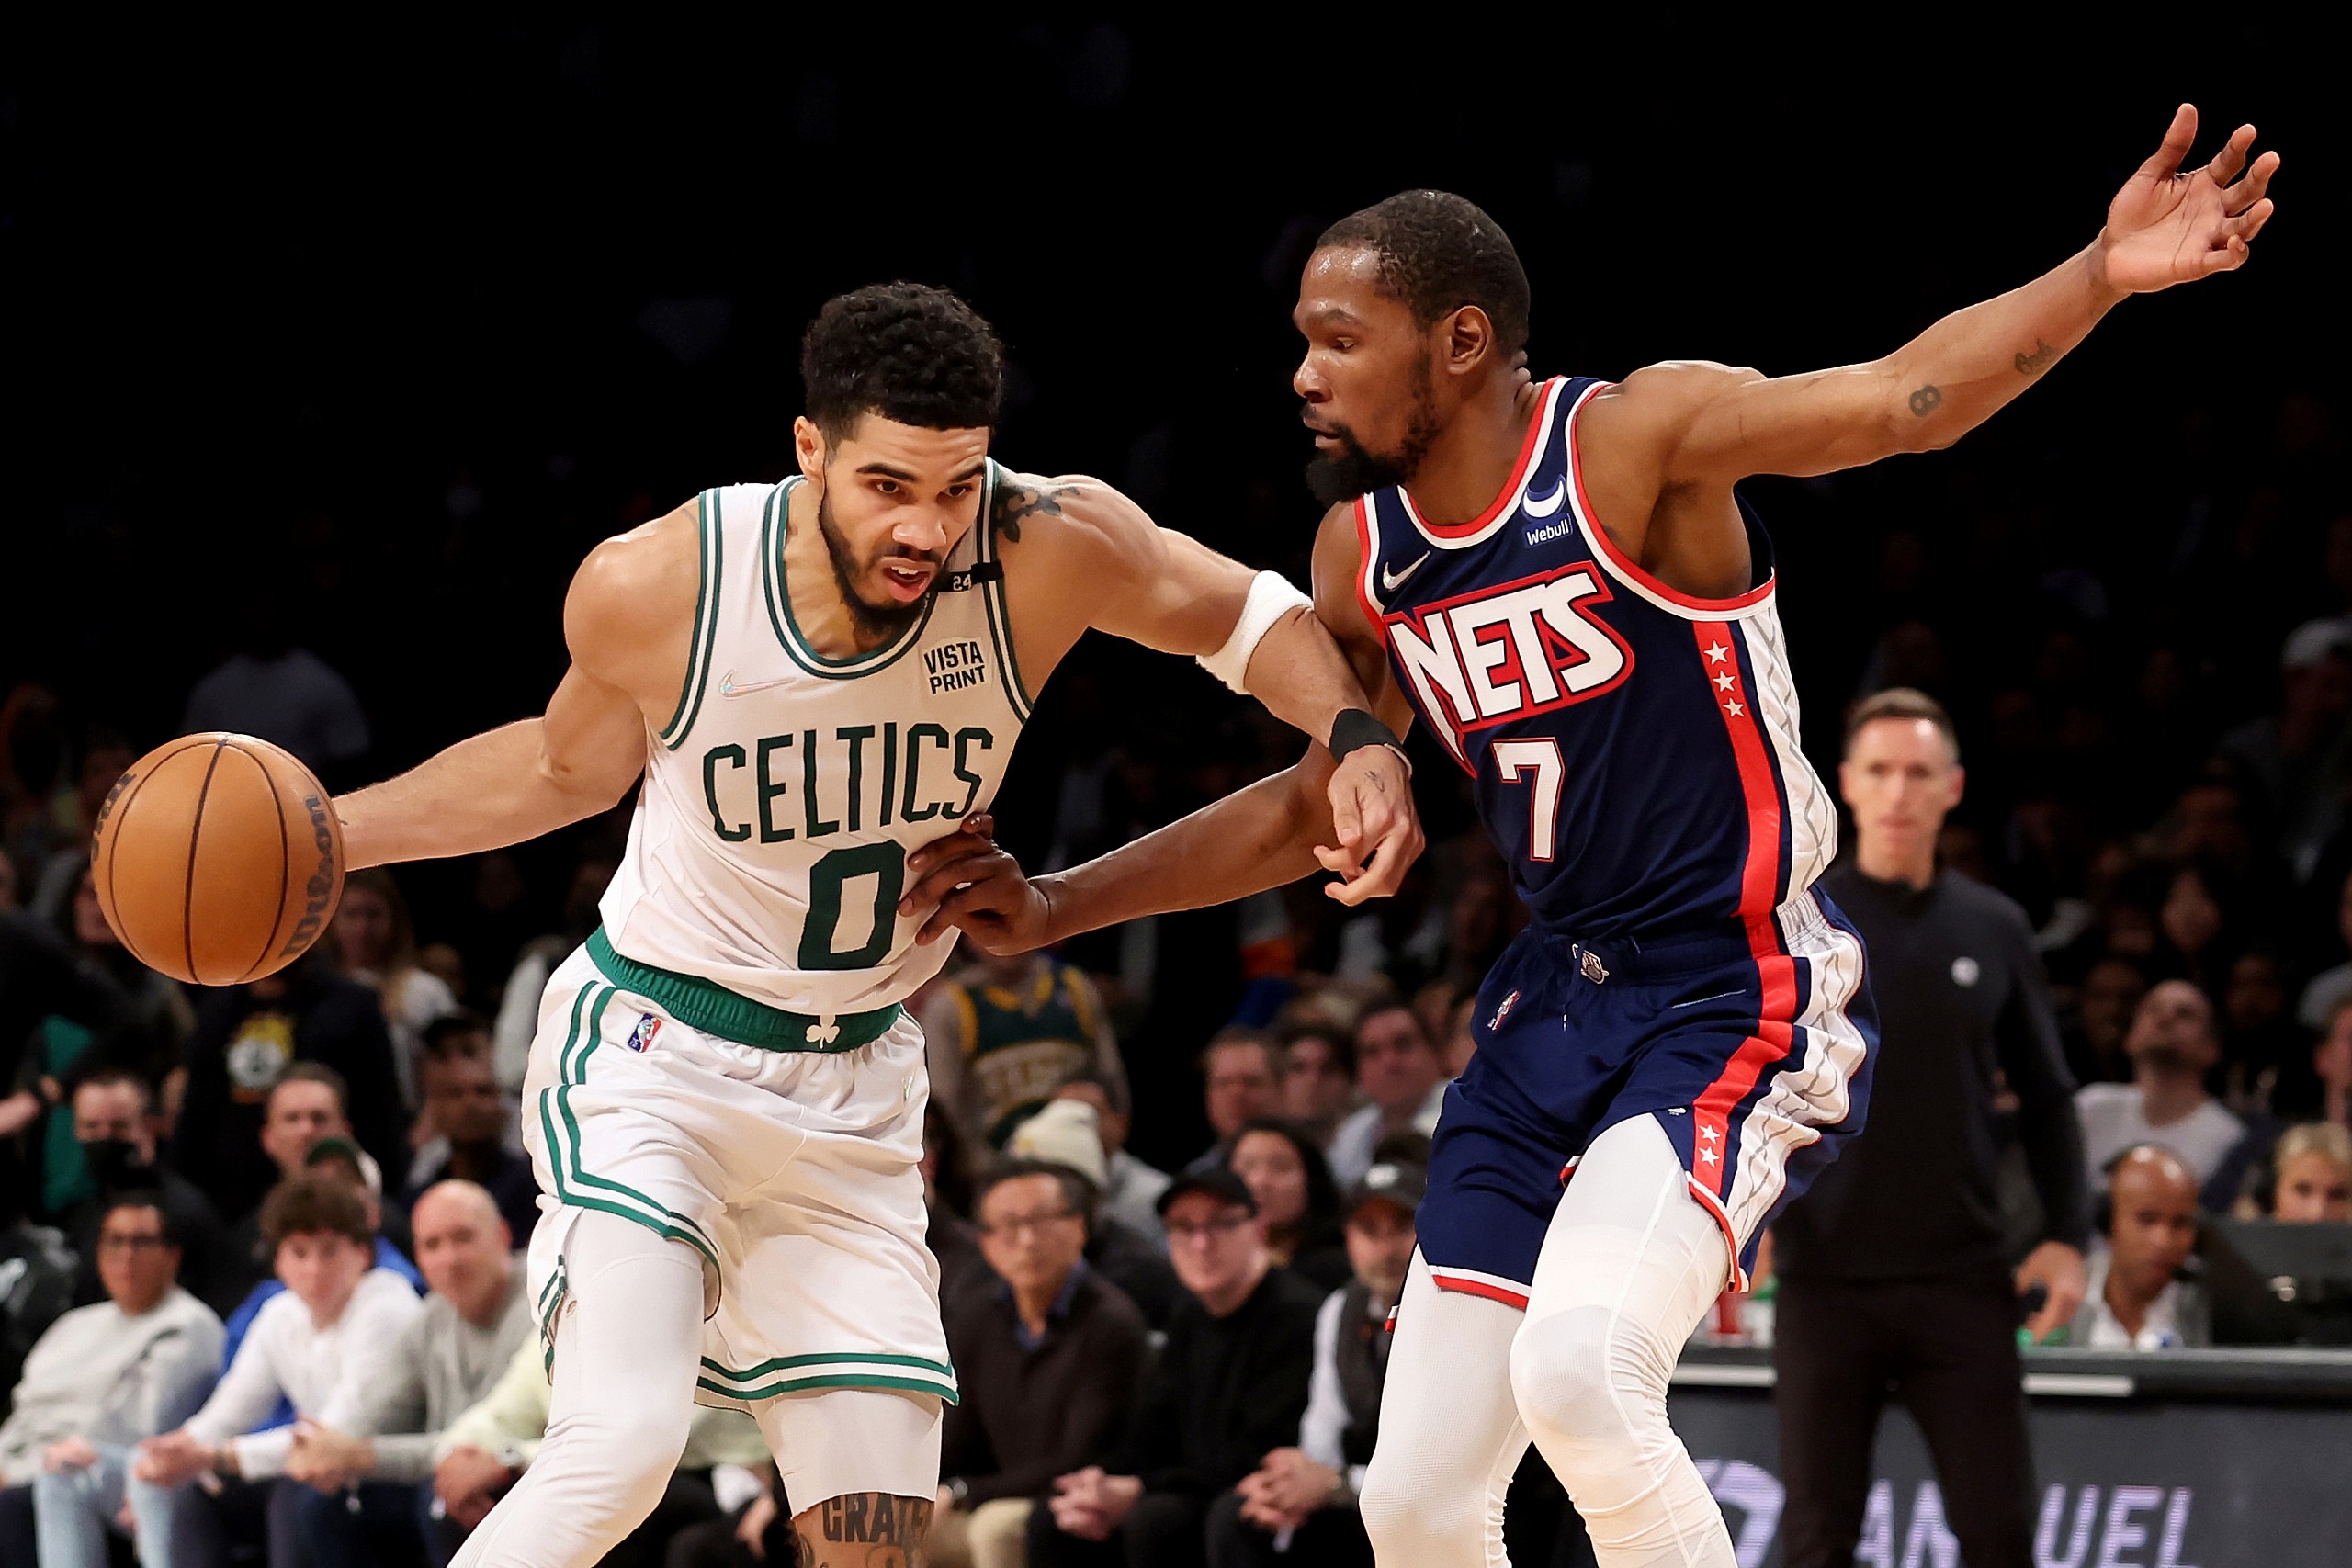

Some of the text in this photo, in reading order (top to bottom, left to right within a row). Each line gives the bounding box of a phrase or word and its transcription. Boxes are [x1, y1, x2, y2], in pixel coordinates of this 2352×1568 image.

[1526, 518, 1569, 546] Webull
[952, 573, 972, 591] 24
[923, 641, 983, 675] VISTA
[929, 664, 987, 694] PRINT
[1386, 570, 1627, 766] NETS
[702, 721, 994, 843] CELTICS
[1491, 738, 1564, 861] 7
[797, 839, 906, 971] 0
[1853, 1478, 2197, 1568] ANUEL
